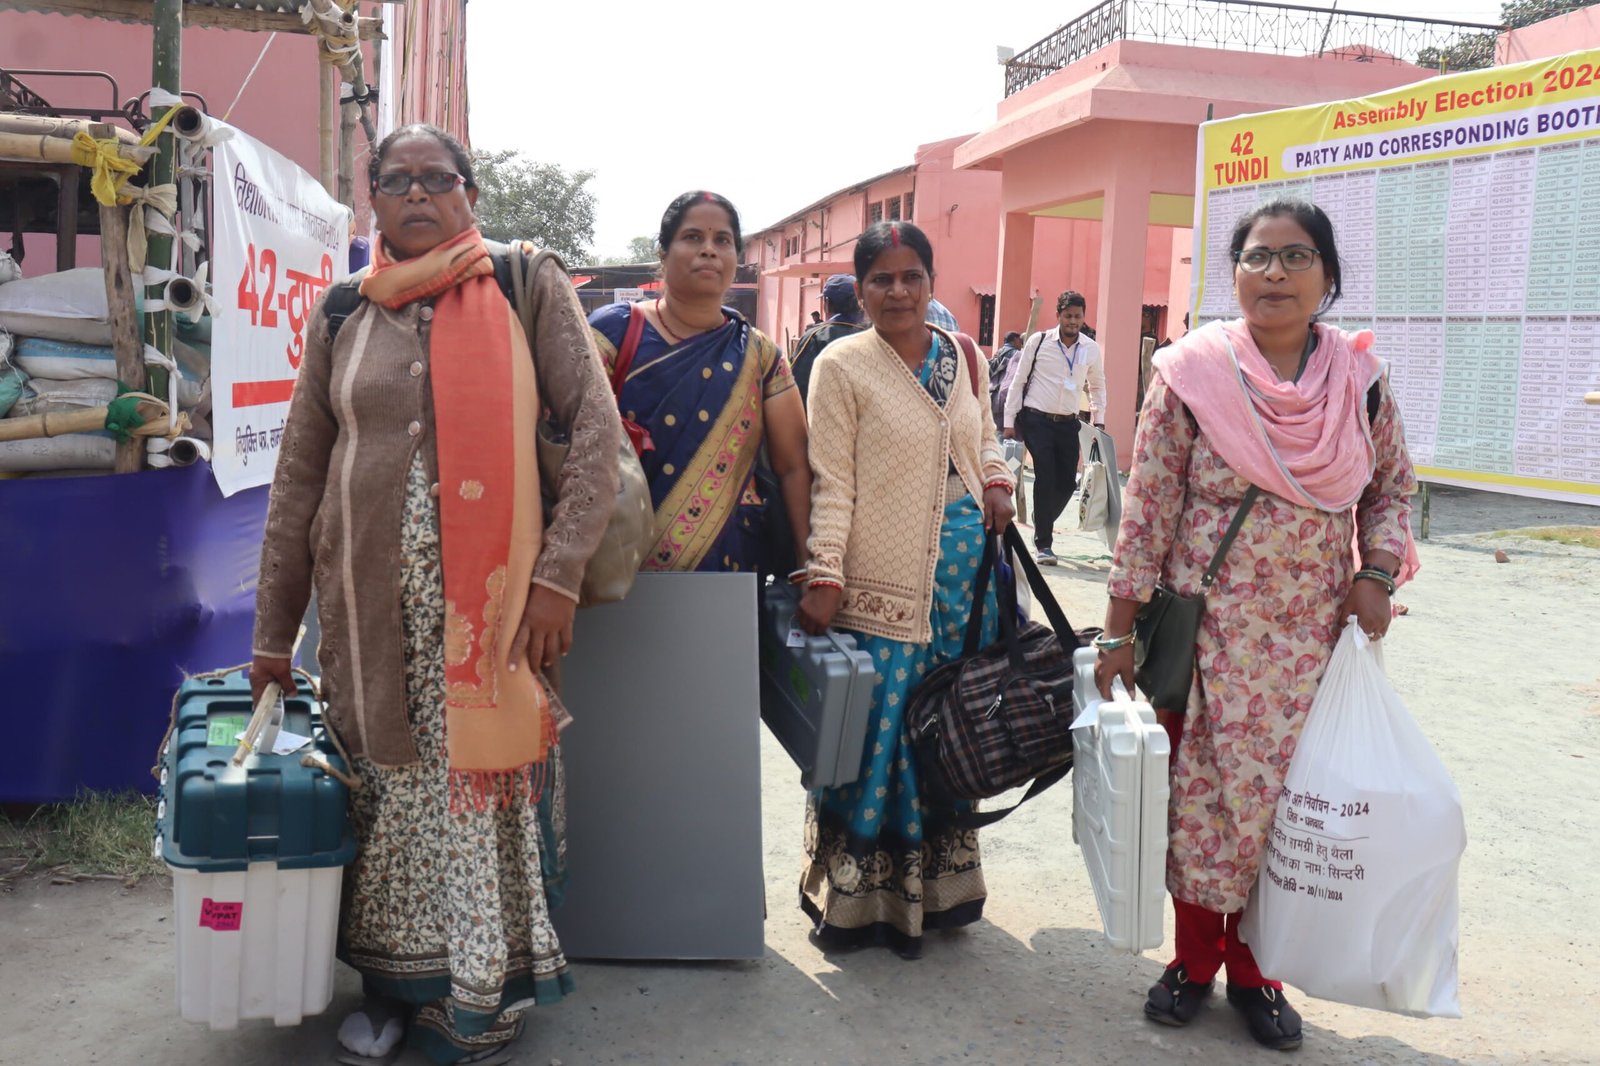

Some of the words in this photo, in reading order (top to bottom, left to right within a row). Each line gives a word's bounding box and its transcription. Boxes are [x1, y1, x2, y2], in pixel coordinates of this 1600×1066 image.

[1333, 98, 1428, 130] Assembly
[1434, 81, 1533, 113] Election
[1231, 131, 1254, 156] 42
[1296, 146, 1340, 168] PARTY
[1343, 142, 1373, 161] AND
[1379, 117, 1529, 155] CORRESPONDING
[1214, 156, 1269, 186] TUNDI
[1303, 791, 1330, 815] निर्वाचन
[1340, 802, 1370, 817] 2024
[1328, 864, 1365, 881] सिन्दरी
[1307, 884, 1343, 901] 20/11/2024
